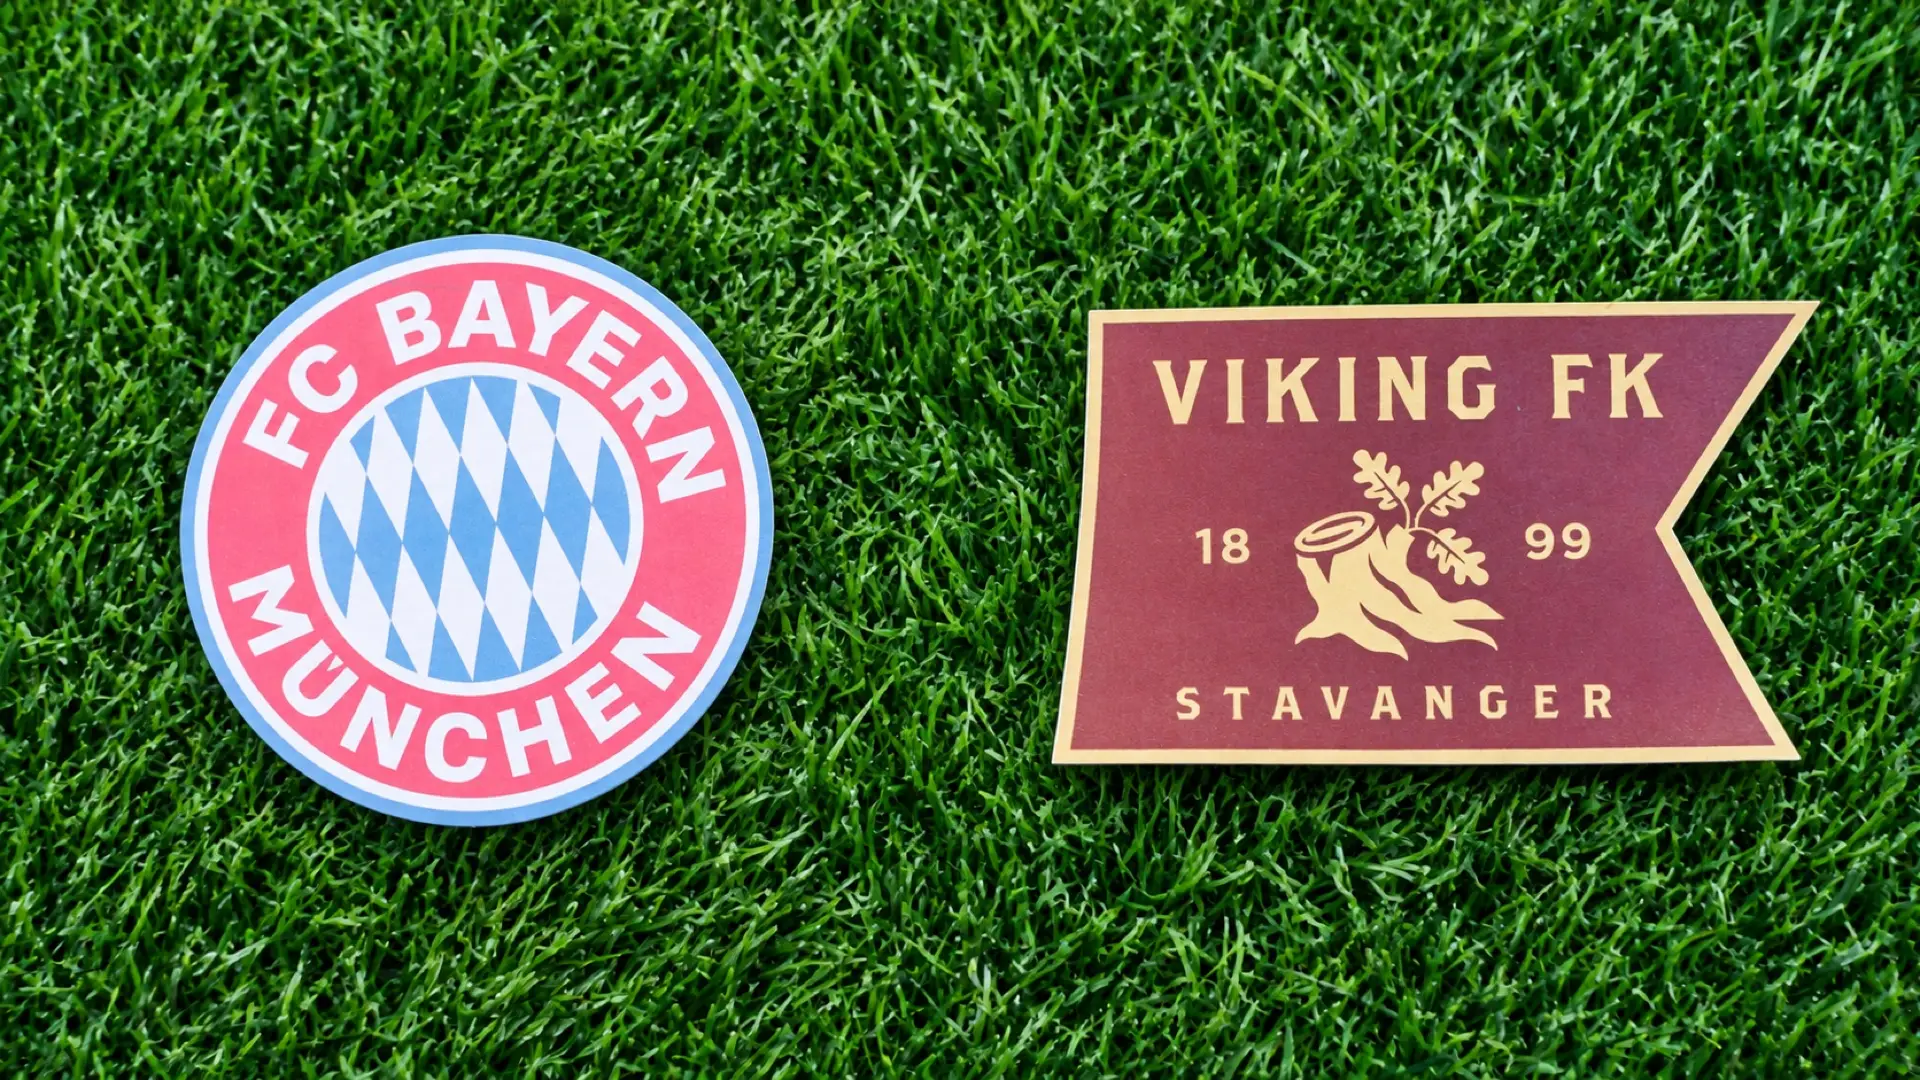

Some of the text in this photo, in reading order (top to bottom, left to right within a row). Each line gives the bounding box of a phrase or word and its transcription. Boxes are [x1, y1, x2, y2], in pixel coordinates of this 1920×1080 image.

[242, 279, 727, 504] FC BAYERN
[1152, 352, 1664, 424] VIKING FK
[1194, 522, 1592, 565] 18 99
[1175, 684, 1613, 720] STAVANGER
